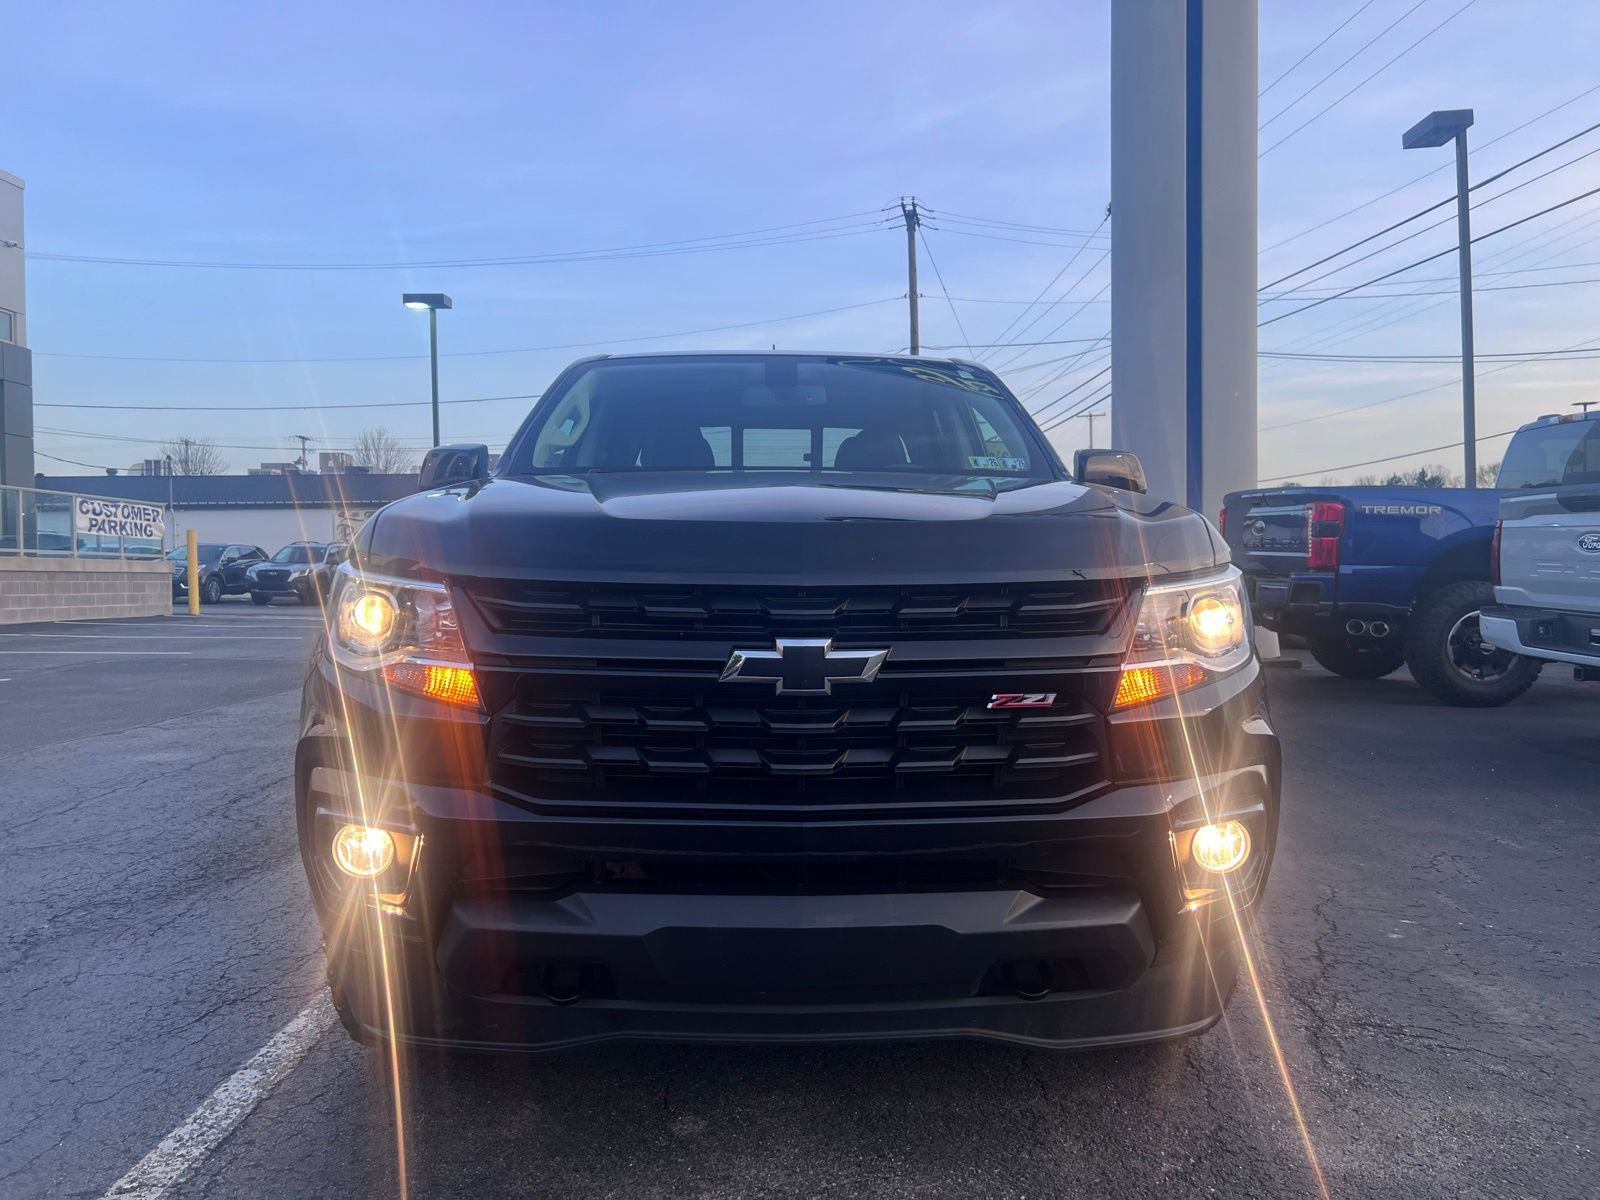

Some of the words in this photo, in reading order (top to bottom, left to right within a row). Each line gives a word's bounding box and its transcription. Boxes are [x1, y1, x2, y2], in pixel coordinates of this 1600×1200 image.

[79, 499, 161, 523] CUSTOMER
[1361, 505, 1442, 514] TREMOR
[88, 517, 153, 538] PARKING
